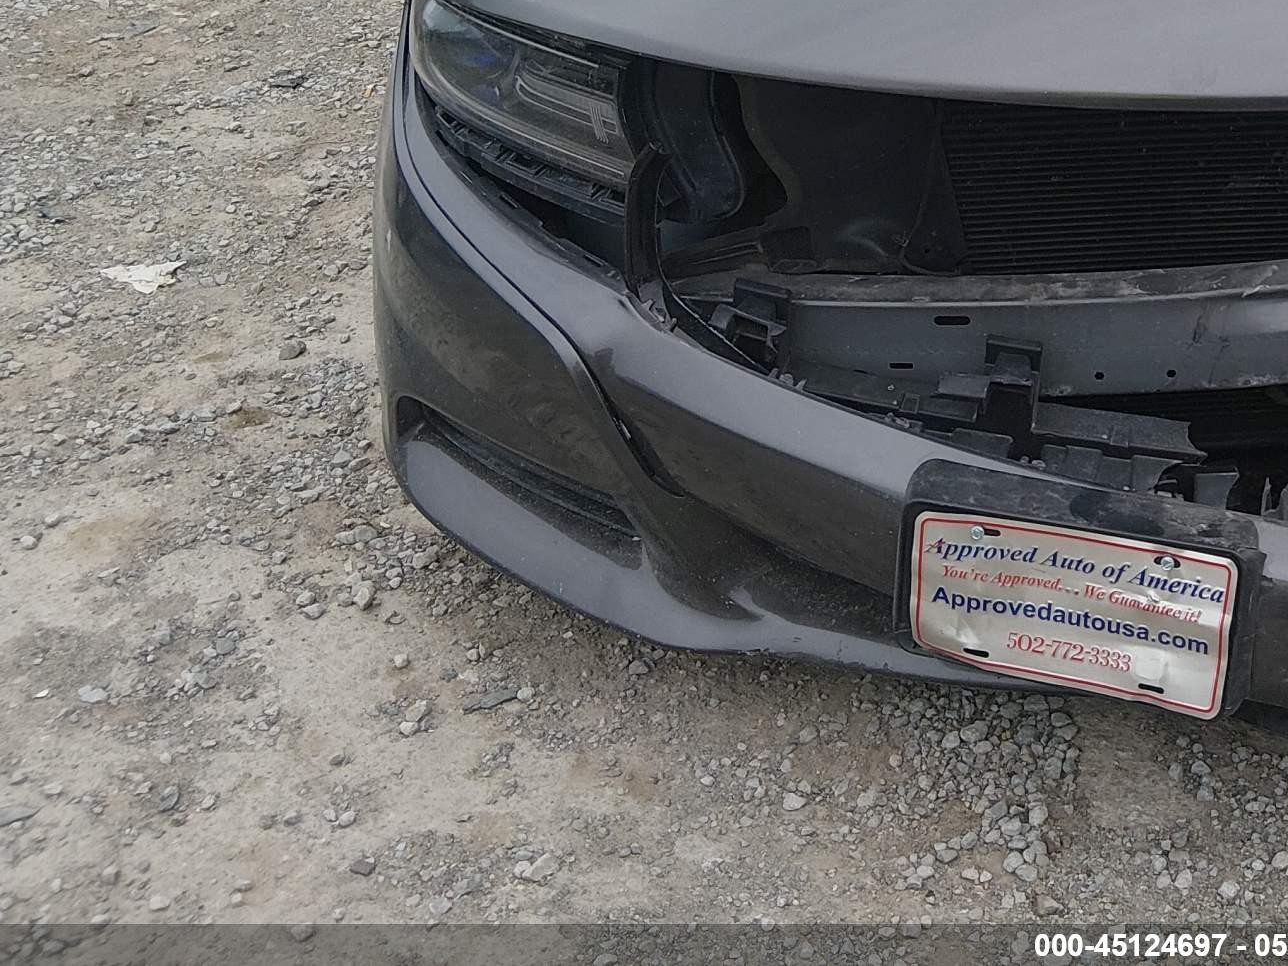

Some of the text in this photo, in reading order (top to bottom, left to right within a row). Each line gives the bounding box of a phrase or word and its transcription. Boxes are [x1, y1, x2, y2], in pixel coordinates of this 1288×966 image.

[926, 537, 1225, 603] Approved Auto of America
[943, 565, 989, 582] You're
[1085, 584, 1106, 600] We
[1109, 589, 1184, 619] Guarantee
[1184, 607, 1202, 623] it!
[932, 586, 1209, 656] Approvedautousa.com
[1006, 632, 1132, 672] 502-772-3333
